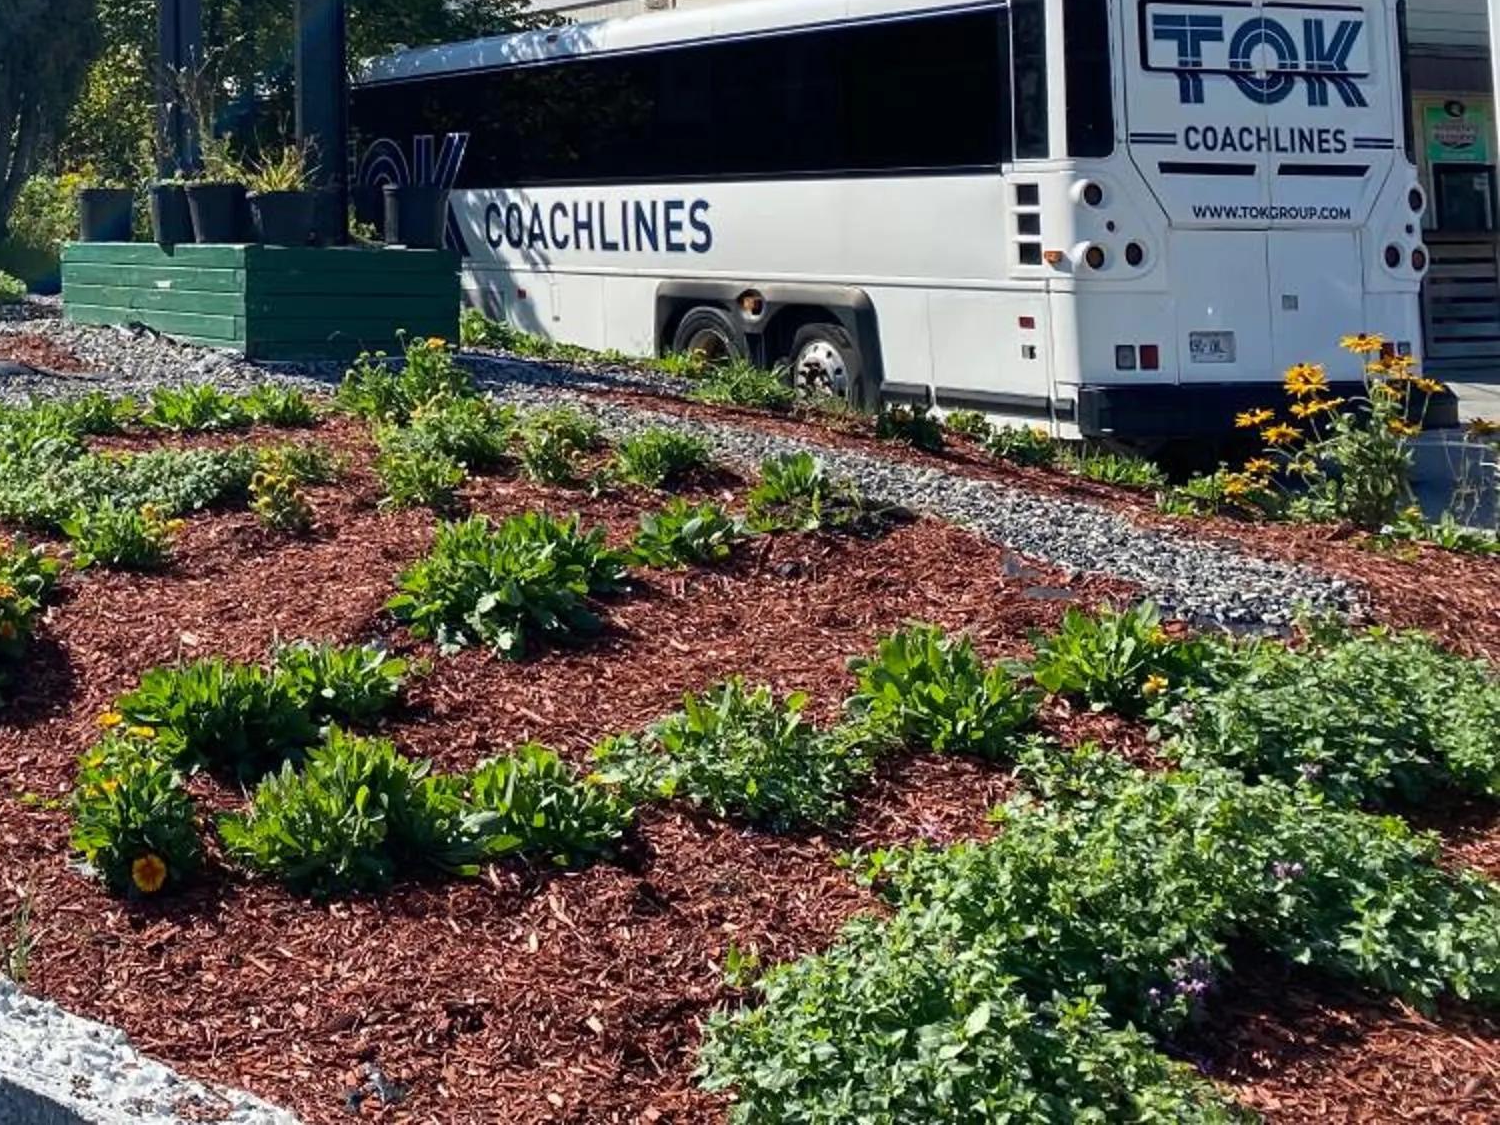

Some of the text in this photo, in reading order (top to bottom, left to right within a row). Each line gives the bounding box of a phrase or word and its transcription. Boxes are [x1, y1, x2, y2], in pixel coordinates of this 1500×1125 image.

[1152, 13, 1369, 108] TOK
[1184, 125, 1347, 154] COACHLINES
[485, 199, 713, 254] COACHLINES
[1192, 205, 1351, 220] WWW.TOKGROUP.COM
